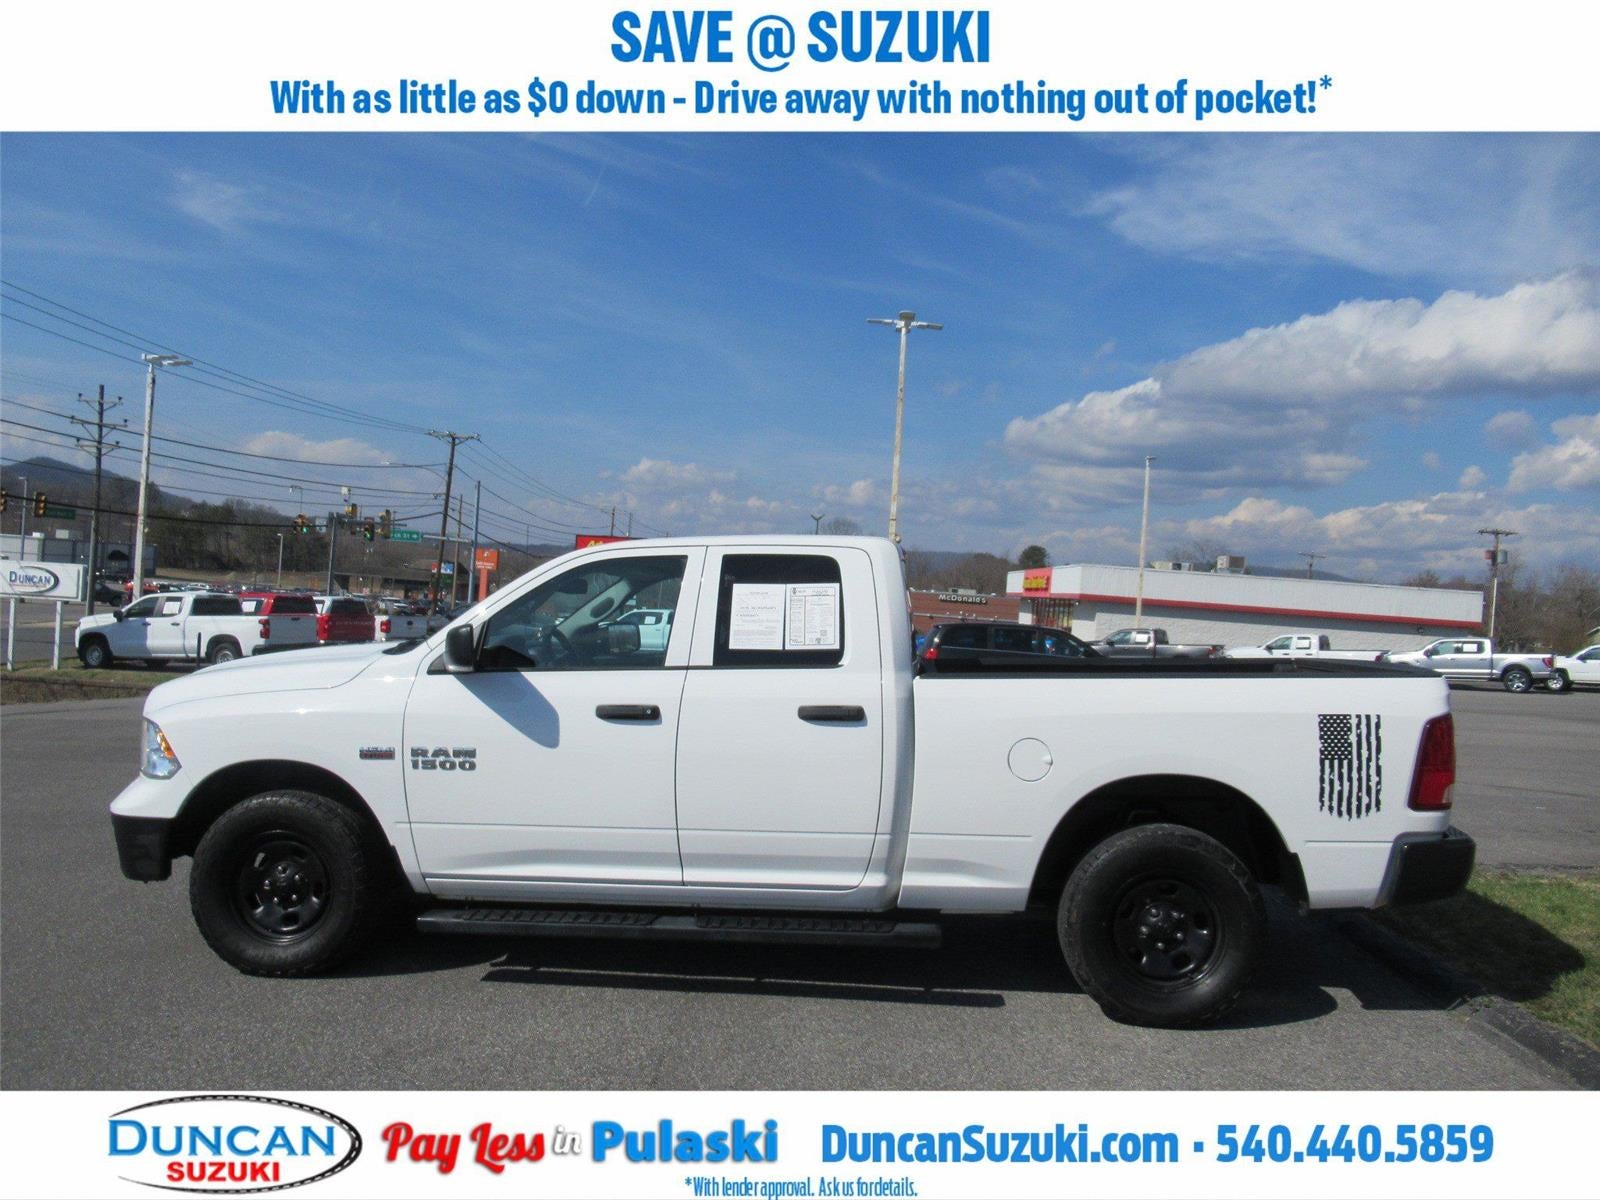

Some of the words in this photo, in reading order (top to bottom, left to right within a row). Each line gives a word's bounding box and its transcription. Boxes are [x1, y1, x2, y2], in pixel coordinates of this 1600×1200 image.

[9, 570, 52, 584] DUNCAN
[411, 747, 476, 759] RAM
[411, 759, 476, 771] 1500
